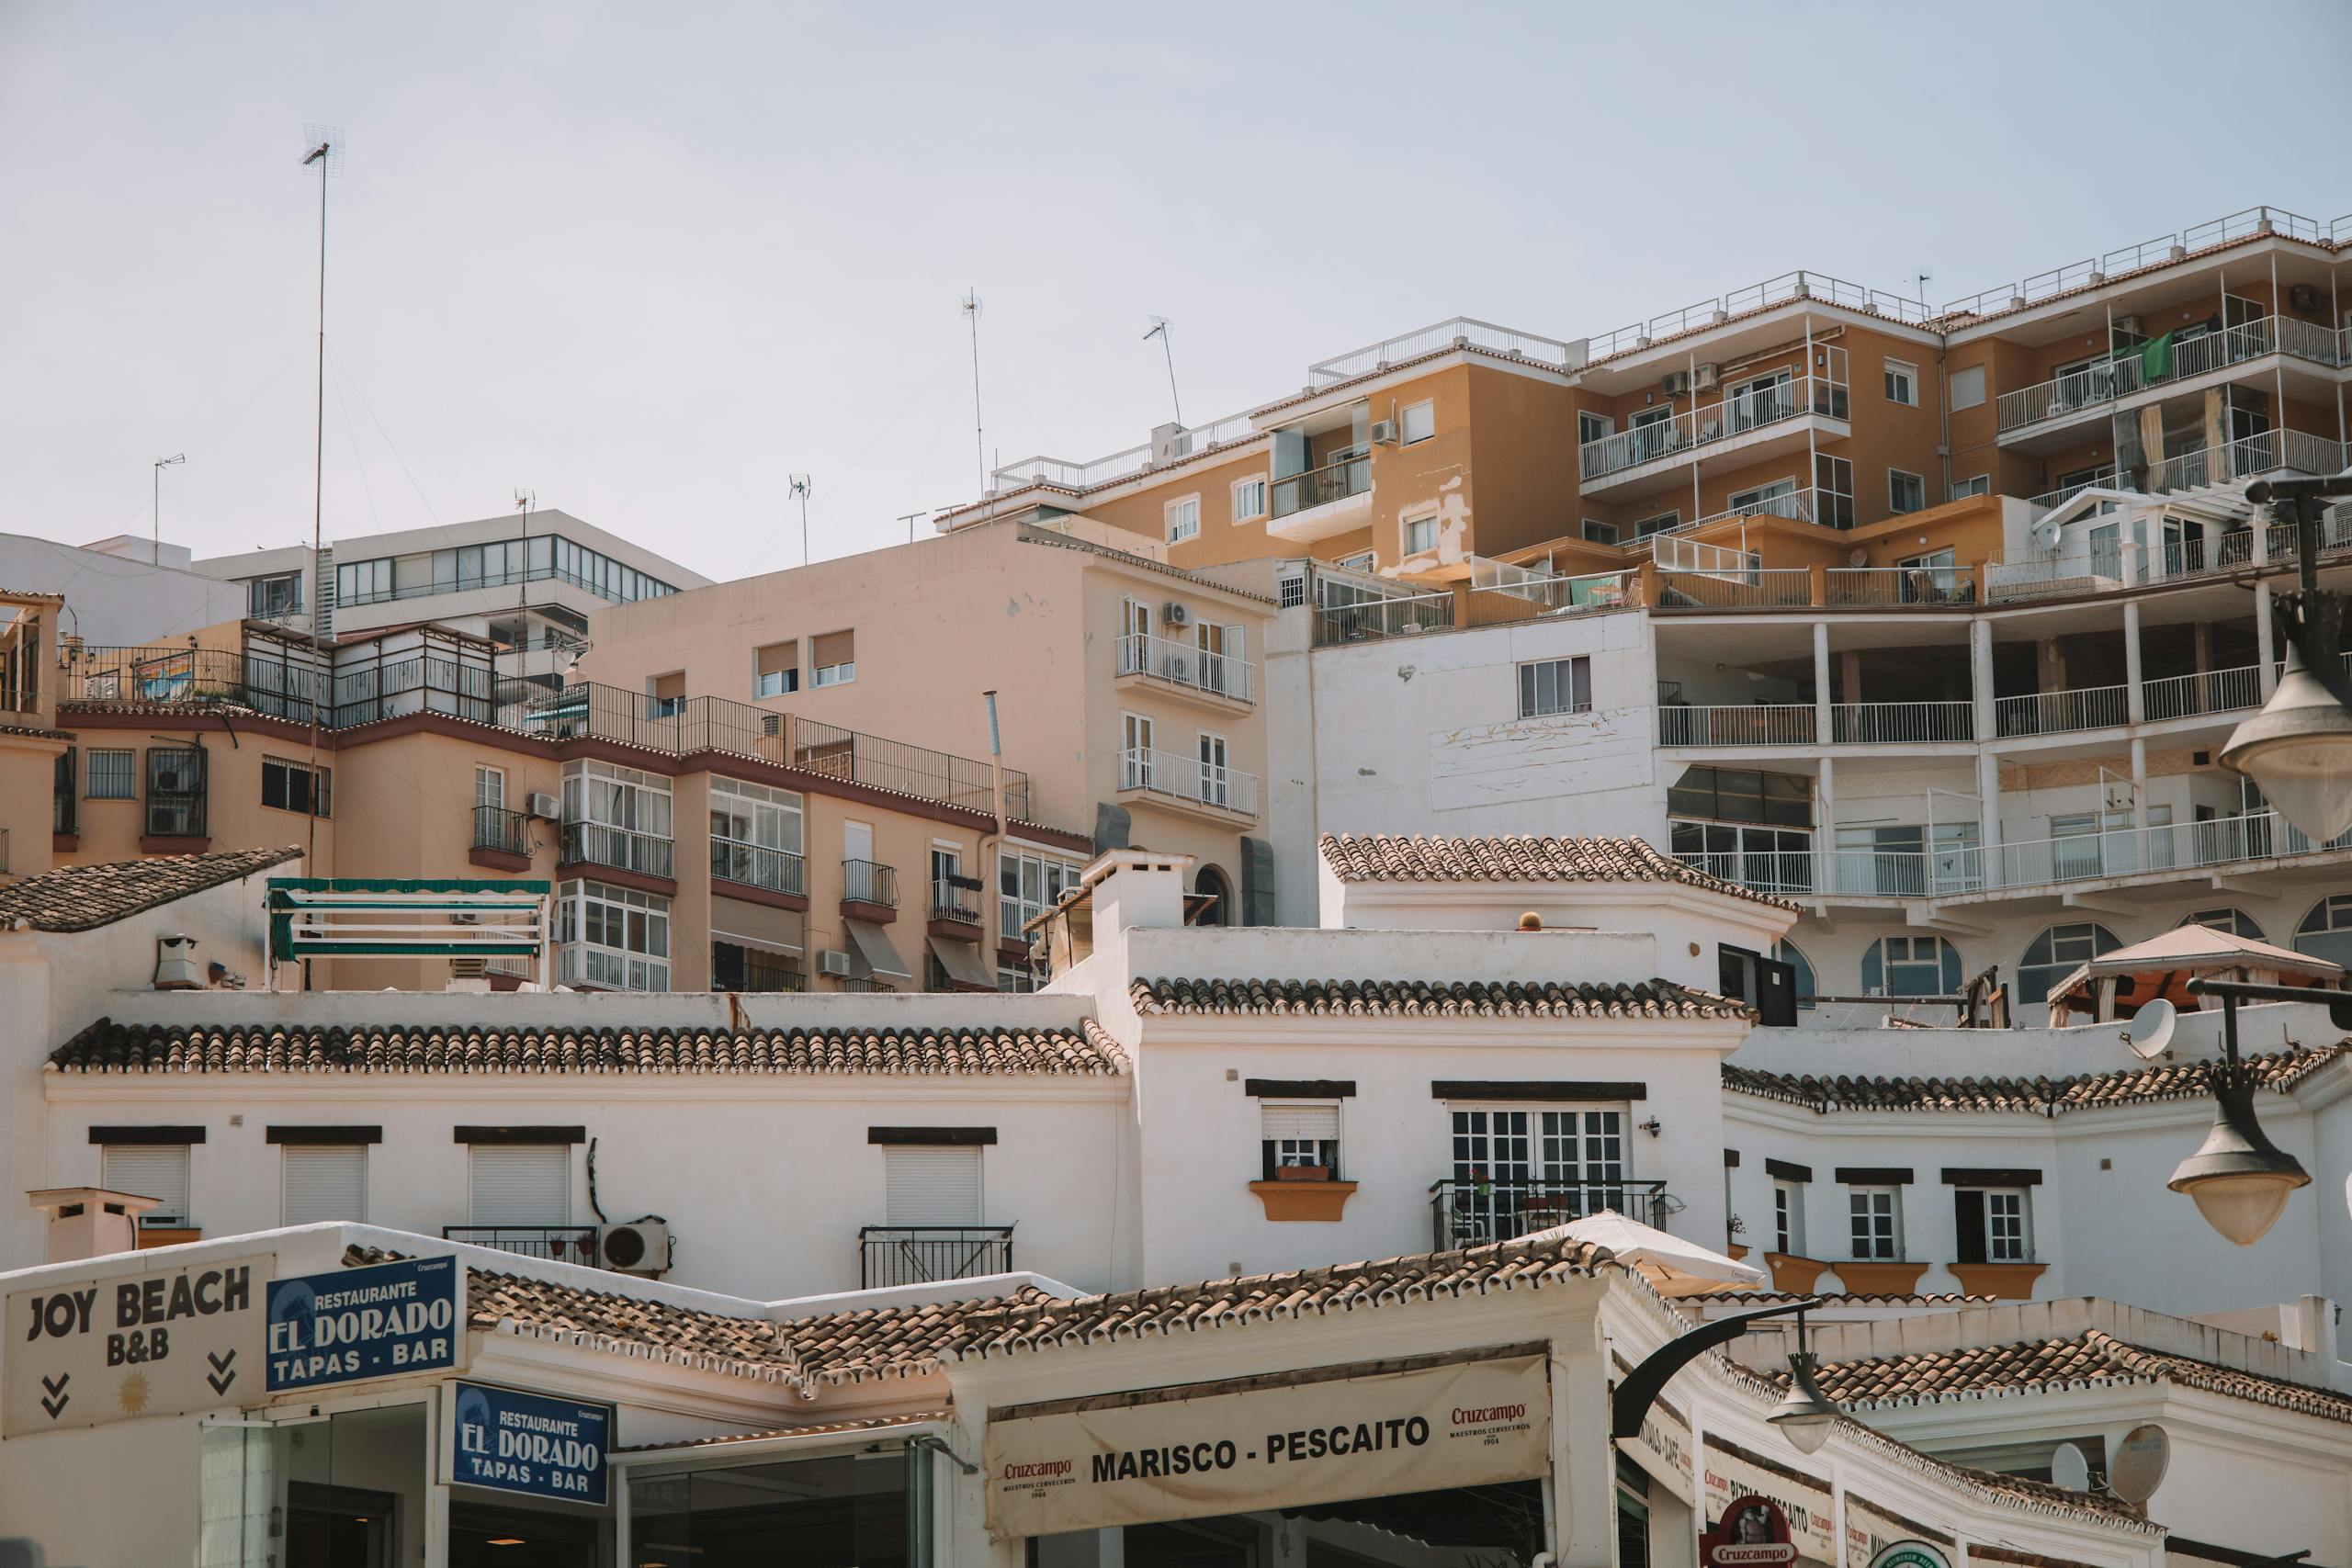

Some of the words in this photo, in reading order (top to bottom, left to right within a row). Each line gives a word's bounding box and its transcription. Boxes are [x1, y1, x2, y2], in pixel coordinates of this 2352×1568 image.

[28, 1288, 97, 1342] JOY
[117, 1266, 250, 1328] BEACH
[314, 1280, 417, 1312] RESTAURANTE
[269, 1320, 306, 1355] EL
[314, 1297, 453, 1348] DORADO
[107, 1326, 170, 1367] B&B
[274, 1350, 361, 1382] TAPAS
[392, 1337, 448, 1366] BAR
[499, 1410, 579, 1438] RESTAURANTE
[1450, 1427, 1487, 1438] MAESTROS
[1487, 1423, 1531, 1434] CERVECEROS
[1452, 1404, 1527, 1425] Cruzcampo
[461, 1423, 490, 1455] EL
[498, 1428, 599, 1472] DORADO
[1091, 1439, 1237, 1483] MARISCO
[1267, 1416, 1430, 1464] PESCAITO
[1483, 1438, 1499, 1446] 1904
[471, 1457, 531, 1483] TAPAS
[551, 1471, 589, 1493] BAR
[1004, 1459, 1073, 1480] Cruzcampo
[1718, 1547, 1788, 1561] Cruzcampo
